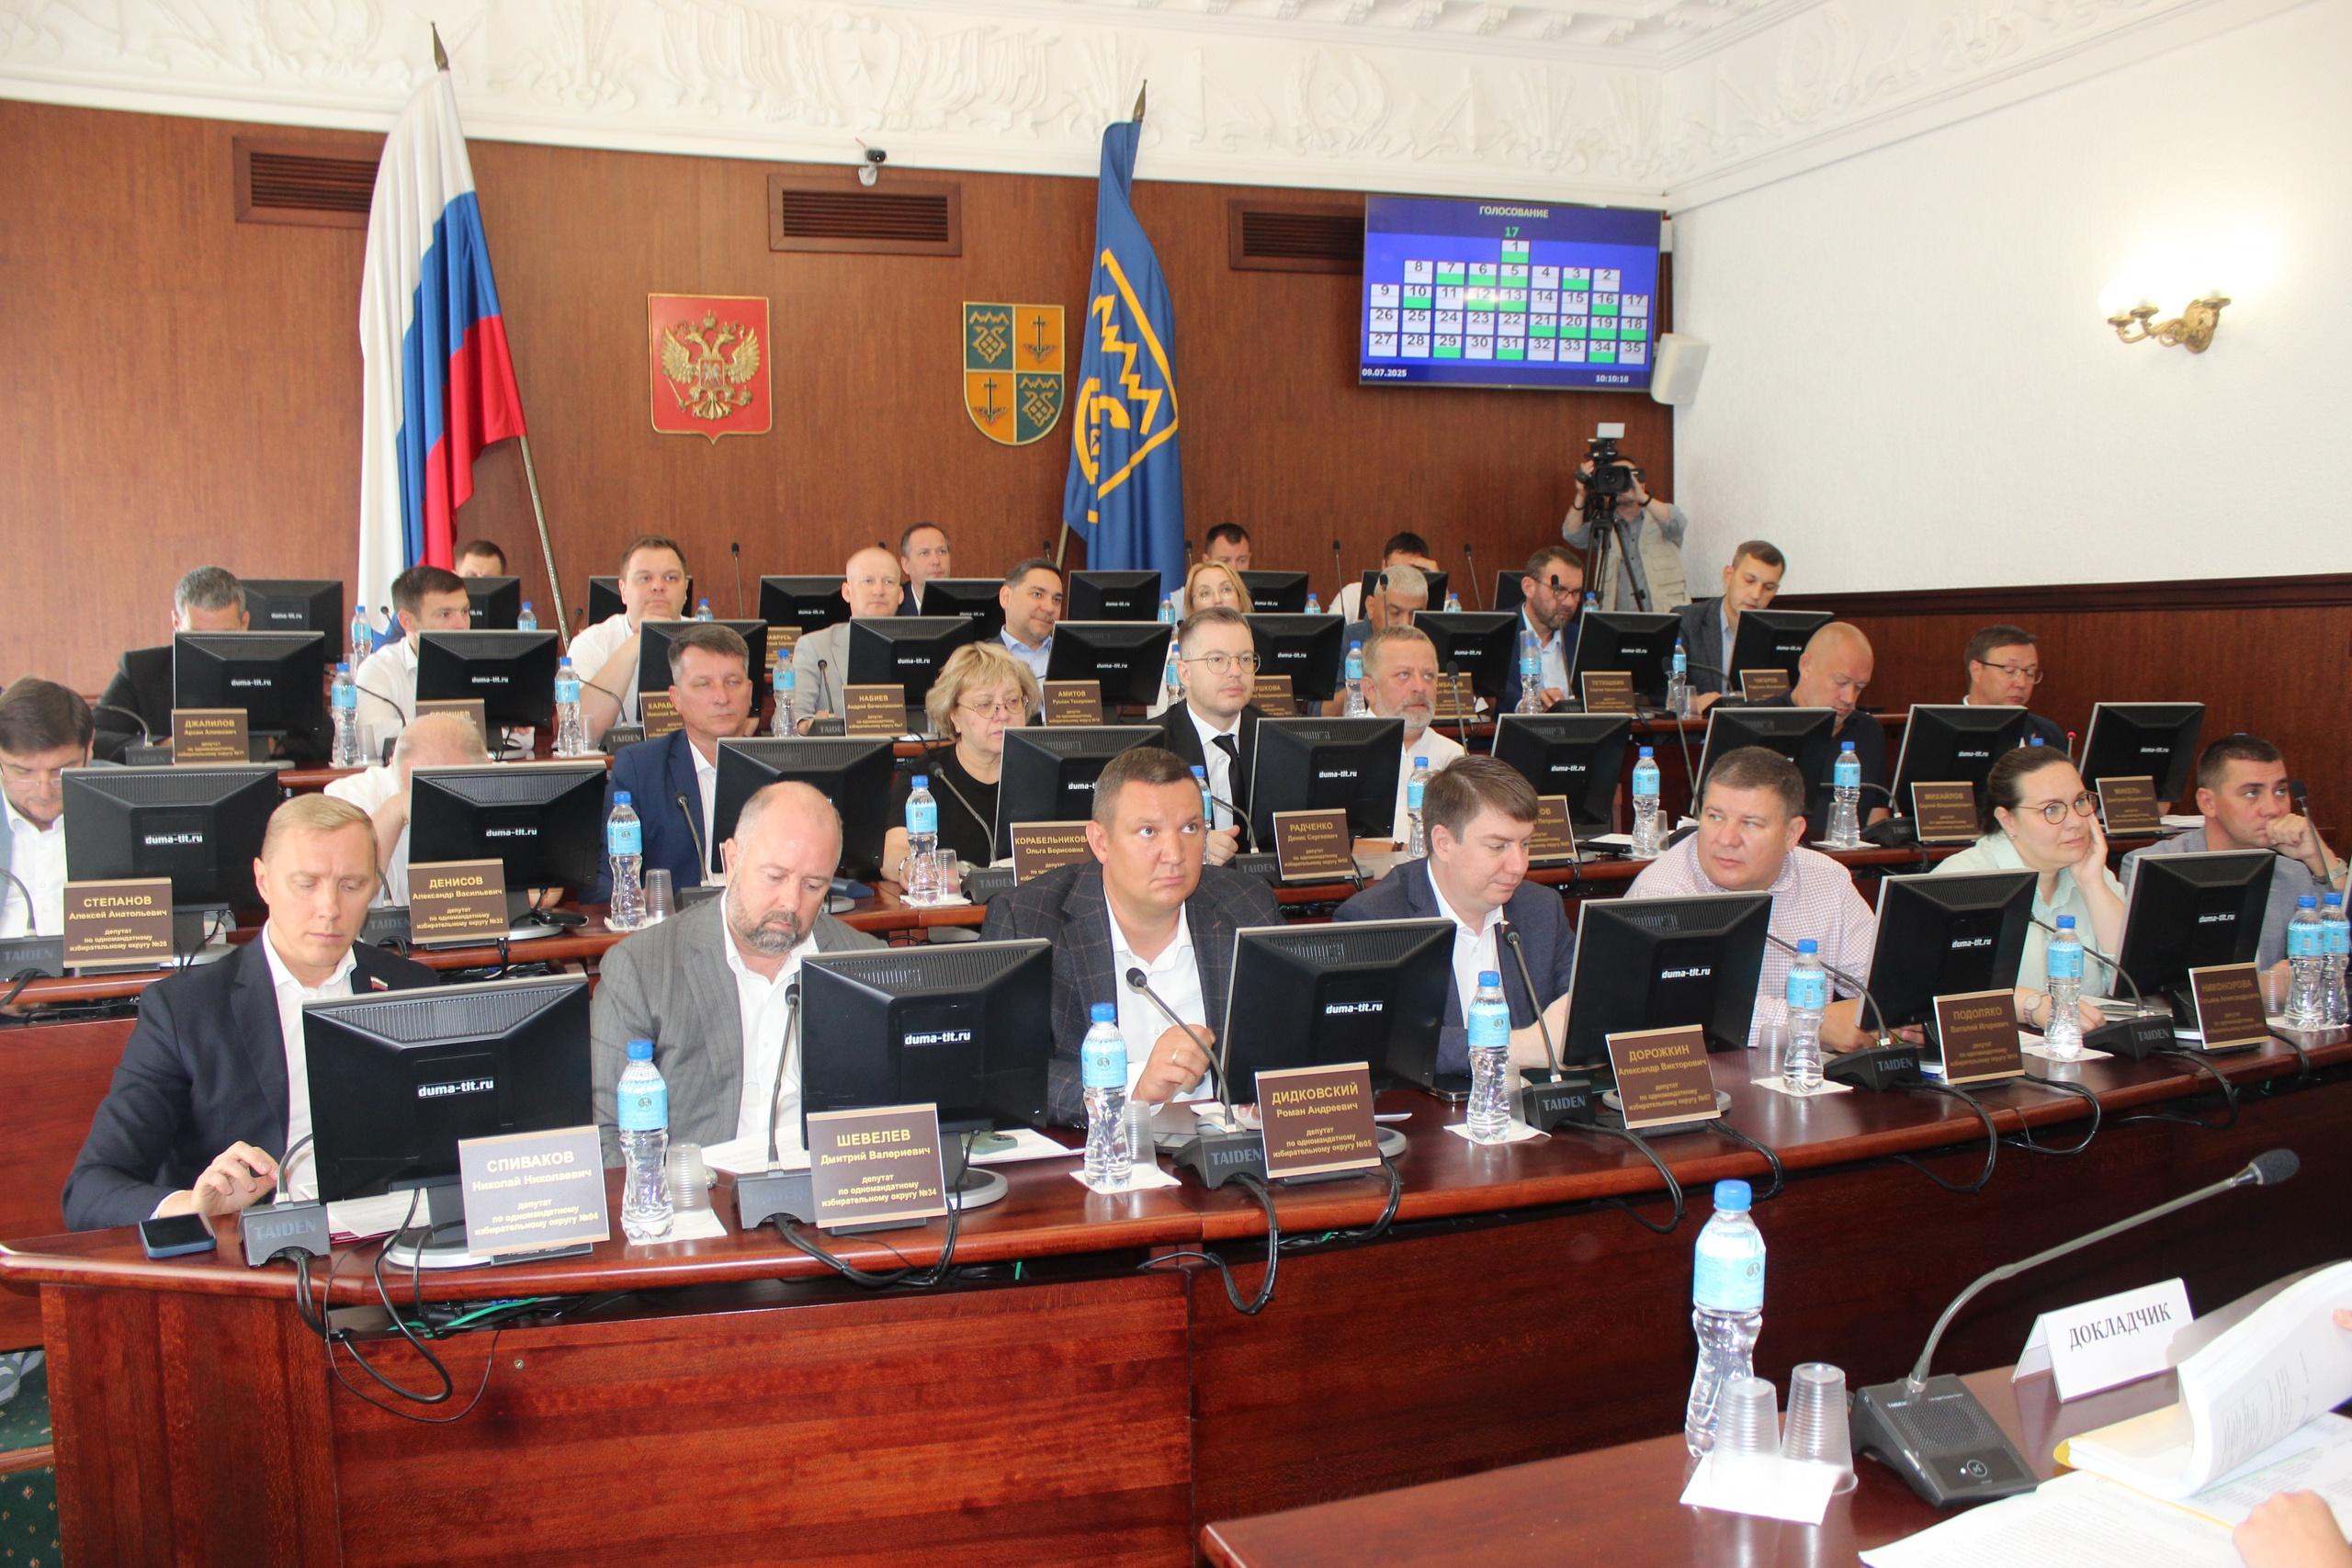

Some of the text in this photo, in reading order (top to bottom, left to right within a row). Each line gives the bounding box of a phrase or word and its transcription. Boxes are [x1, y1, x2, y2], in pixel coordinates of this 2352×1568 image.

[1479, 206, 1549, 219] ГОЛОСОВАНИЕ
[1504, 226, 1520, 237] 17
[1414, 262, 1611, 280] 8 7 6 5 4 3 2
[1380, 286, 1644, 306] 9 10 11 12 13 14 15 16 17
[1374, 310, 1643, 329] 26 25 24 23 22 21 20 19 18
[1374, 333, 1642, 353] 27 28 29 30 31 32 33 34 35
[1362, 368, 1408, 378] 09.07.2025
[185, 719, 235, 728] ДЖАЛИЛОВ
[820, 725, 844, 733] TAIDE
[612, 734, 641, 743] TAIDEN
[1318, 770, 1358, 778] duma-tlt.ru
[1069, 782, 1096, 790] duma-t
[485, 828, 537, 837] duma-tlt.ru
[1290, 822, 1333, 832] РАДЧЕНКО
[144, 833, 203, 845] duma-tlt.ru
[1242, 863, 1276, 874] TAIDEN
[429, 876, 484, 889] ДЕНИСОВ
[413, 888, 503, 900] Александр Васильевич
[84, 896, 153, 908] СТЕПАНОВ
[68, 910, 167, 920] Алексей Анатольевич
[1661, 966, 1711, 979] duma-tlt.ru
[1325, 1001, 1384, 1015] duma-tlt.ru
[1953, 1006, 2003, 1021] ПОДОЛЯКО
[905, 1030, 971, 1046] duma-tlt.ru
[1629, 1044, 1690, 1063] ДОРОЖКИН
[1618, 1058, 1707, 1077] Александр Викторович
[1877, 1057, 1914, 1073] TAIDEN
[418, 1078, 494, 1098] duma-tlt.ru
[1272, 1081, 1359, 1105] ДИДКОВСКИЙ
[1276, 1102, 1359, 1118] Роман Андреевич
[1542, 1096, 1587, 1111] TAIDEN
[837, 1129, 911, 1147] ШЕВЕЛЕВ
[1306, 1126, 1334, 1136] депутат
[1296, 1134, 1356, 1147] одномандатному
[820, 1146, 931, 1167] Дмитрий Валериевич
[1272, 1146, 1330, 1157] избирательному
[1332, 1143, 1355, 1151] округу
[487, 1151, 575, 1173] СПИВАКОВ
[1211, 1149, 1263, 1166] TAIDEN
[472, 1169, 592, 1191] Николай Николаевич
[862, 1174, 894, 1184] депутат
[851, 1181, 919, 1194] одномандатному
[517, 1199, 552, 1211] депутат
[821, 1194, 889, 1207] избирательному
[890, 1191, 917, 1201] округу
[505, 1205, 580, 1223] одномандатному
[254, 1219, 317, 1240] TAIDEN
[474, 1220, 548, 1235] избирательному
[548, 1216, 578, 1227] округу
[2069, 1302, 2172, 1351] ДОКЛАДЧИК
